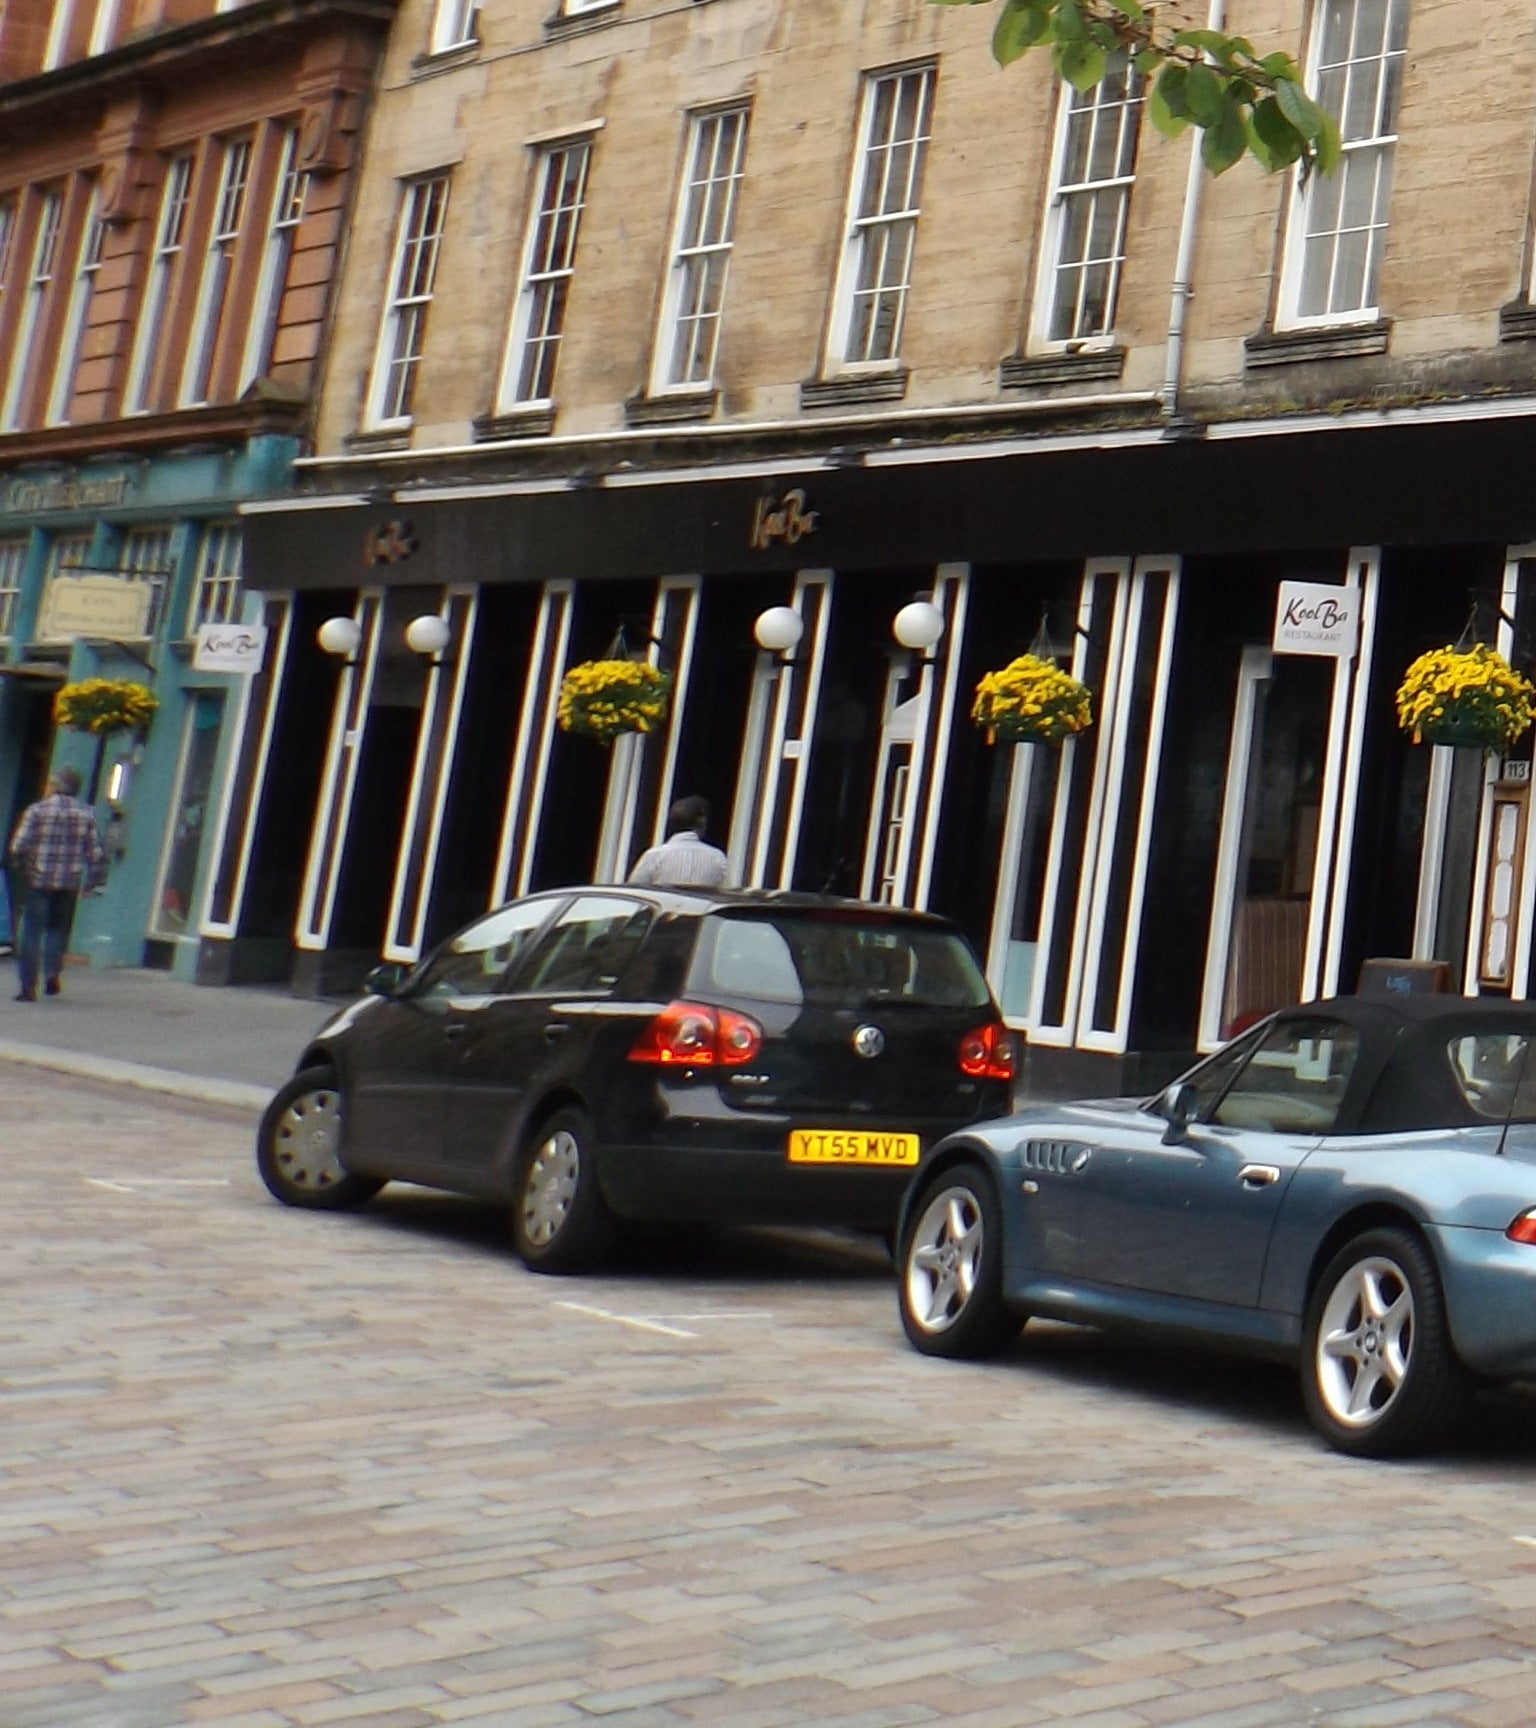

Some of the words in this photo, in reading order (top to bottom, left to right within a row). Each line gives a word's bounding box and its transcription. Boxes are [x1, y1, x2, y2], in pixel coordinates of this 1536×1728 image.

[1508, 763, 1526, 778] 113
[801, 1136, 858, 1157] YT55
[867, 1138, 907, 1159] MVD
